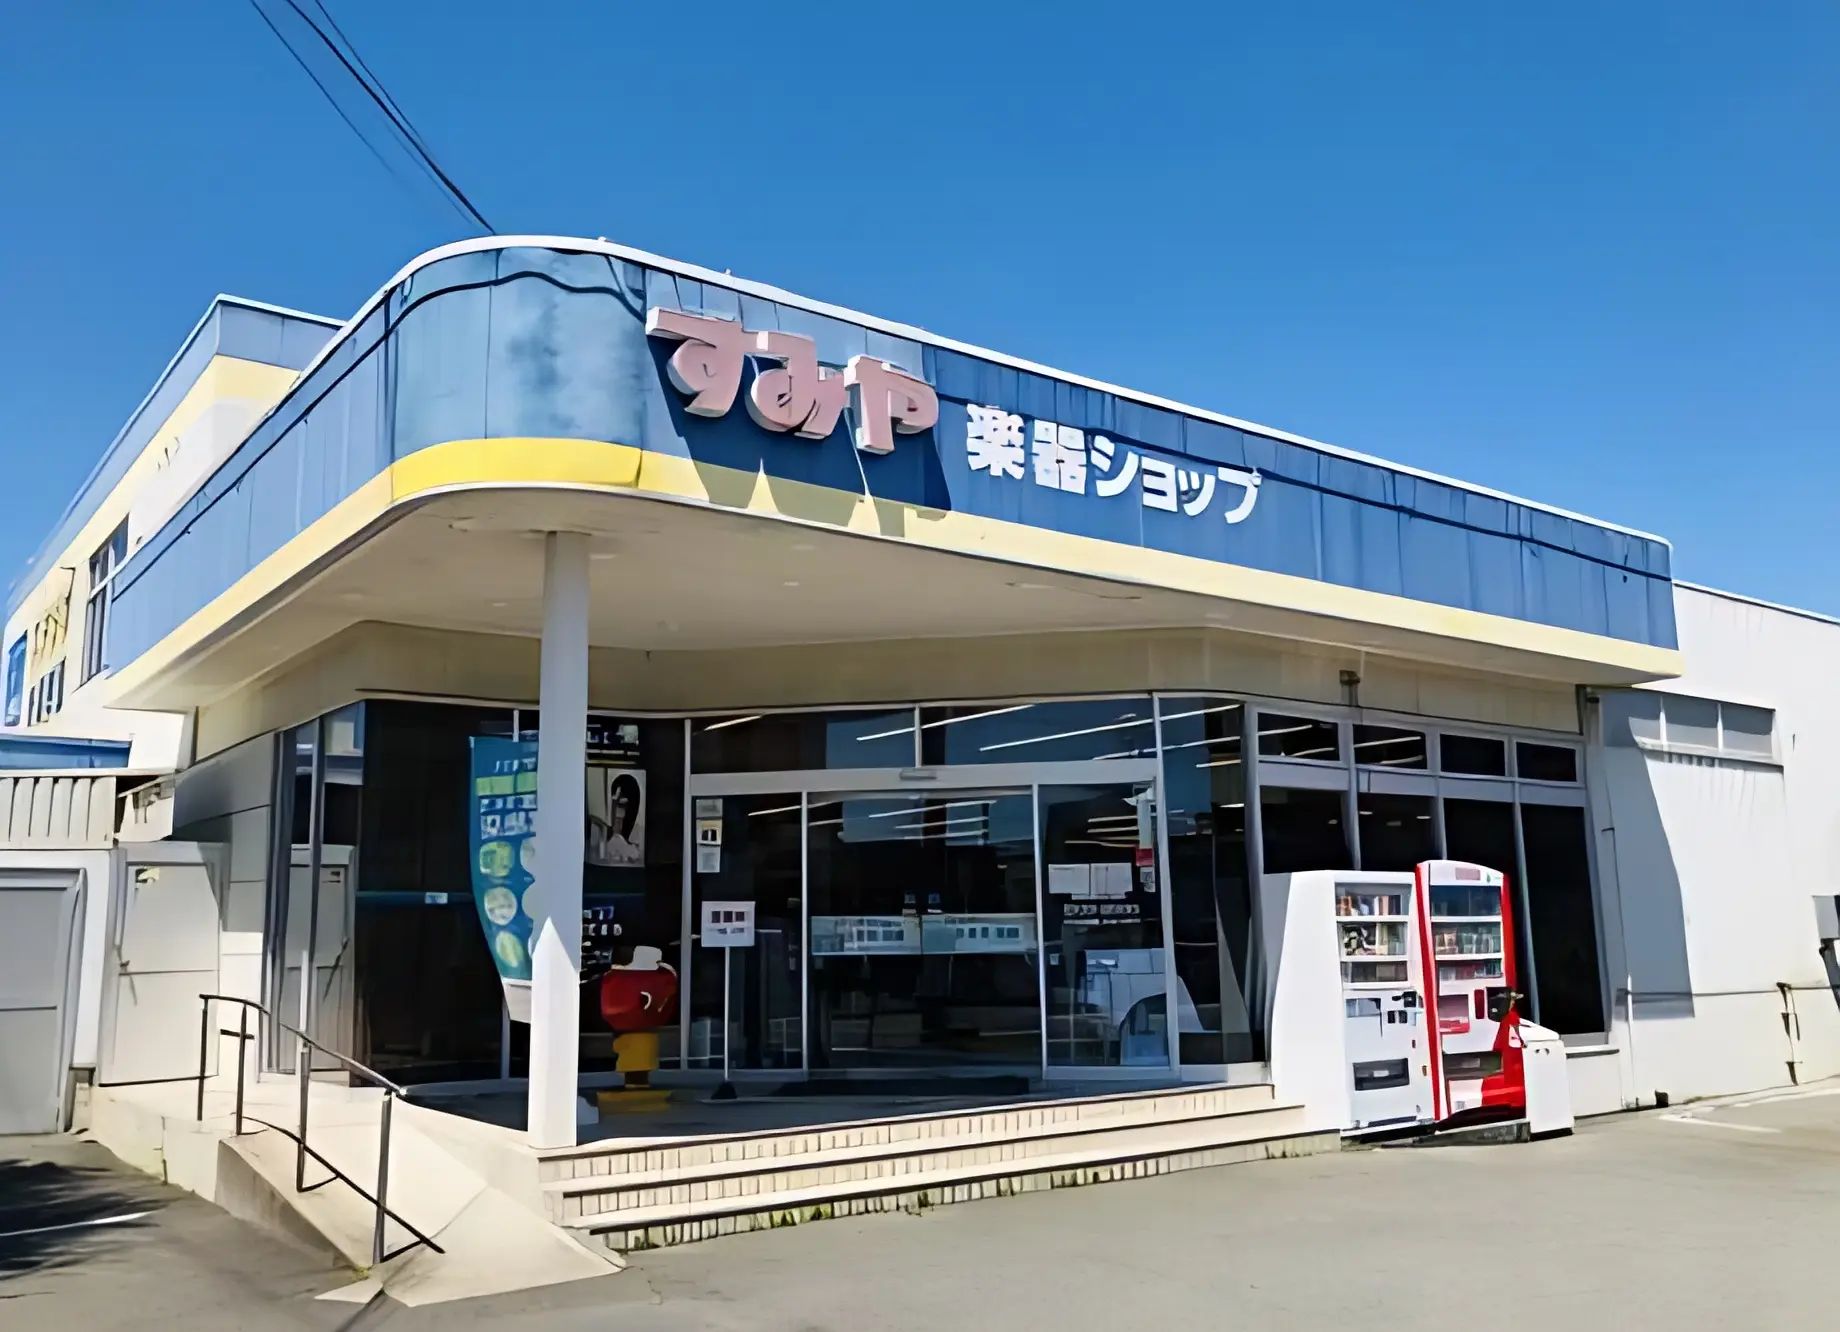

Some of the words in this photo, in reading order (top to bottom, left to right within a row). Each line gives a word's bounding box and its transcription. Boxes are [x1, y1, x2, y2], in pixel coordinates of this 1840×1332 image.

[645, 306, 939, 455] すみや
[966, 403, 1262, 524] 楽器ショップ
